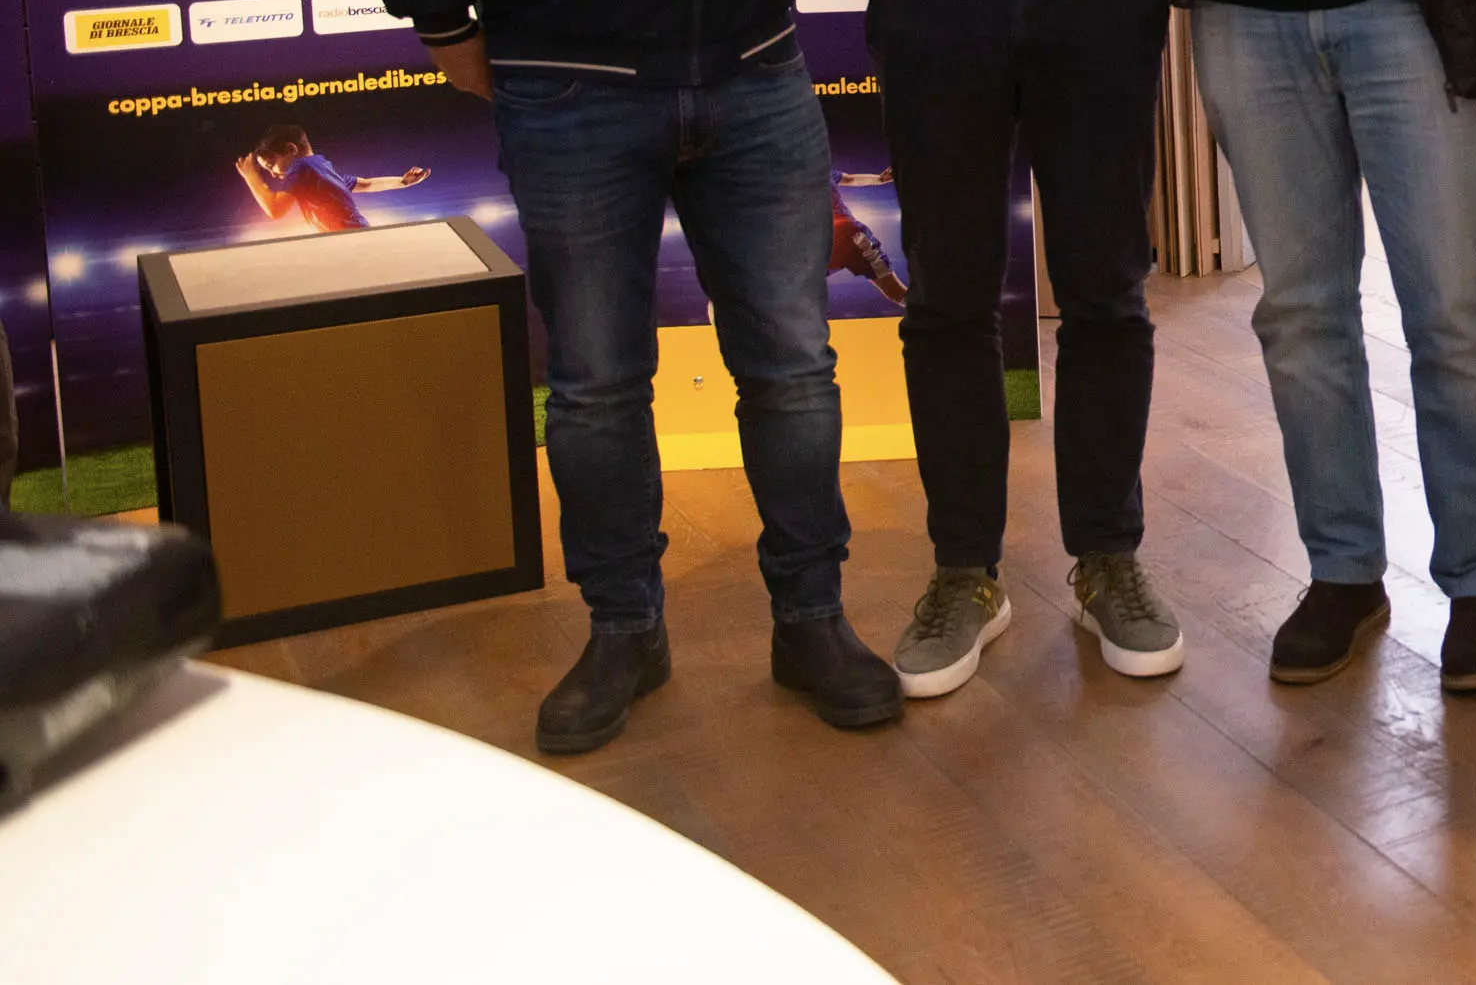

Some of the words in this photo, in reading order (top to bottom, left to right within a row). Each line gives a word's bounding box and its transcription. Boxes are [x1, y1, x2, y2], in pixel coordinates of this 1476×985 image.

[92, 17, 156, 31] GIORNALE
[224, 13, 294, 25] TELETUTTO
[89, 30, 103, 40] DI
[106, 26, 160, 38] BRESCIA
[107, 69, 448, 116] coppa-brescia.giornaledibres
